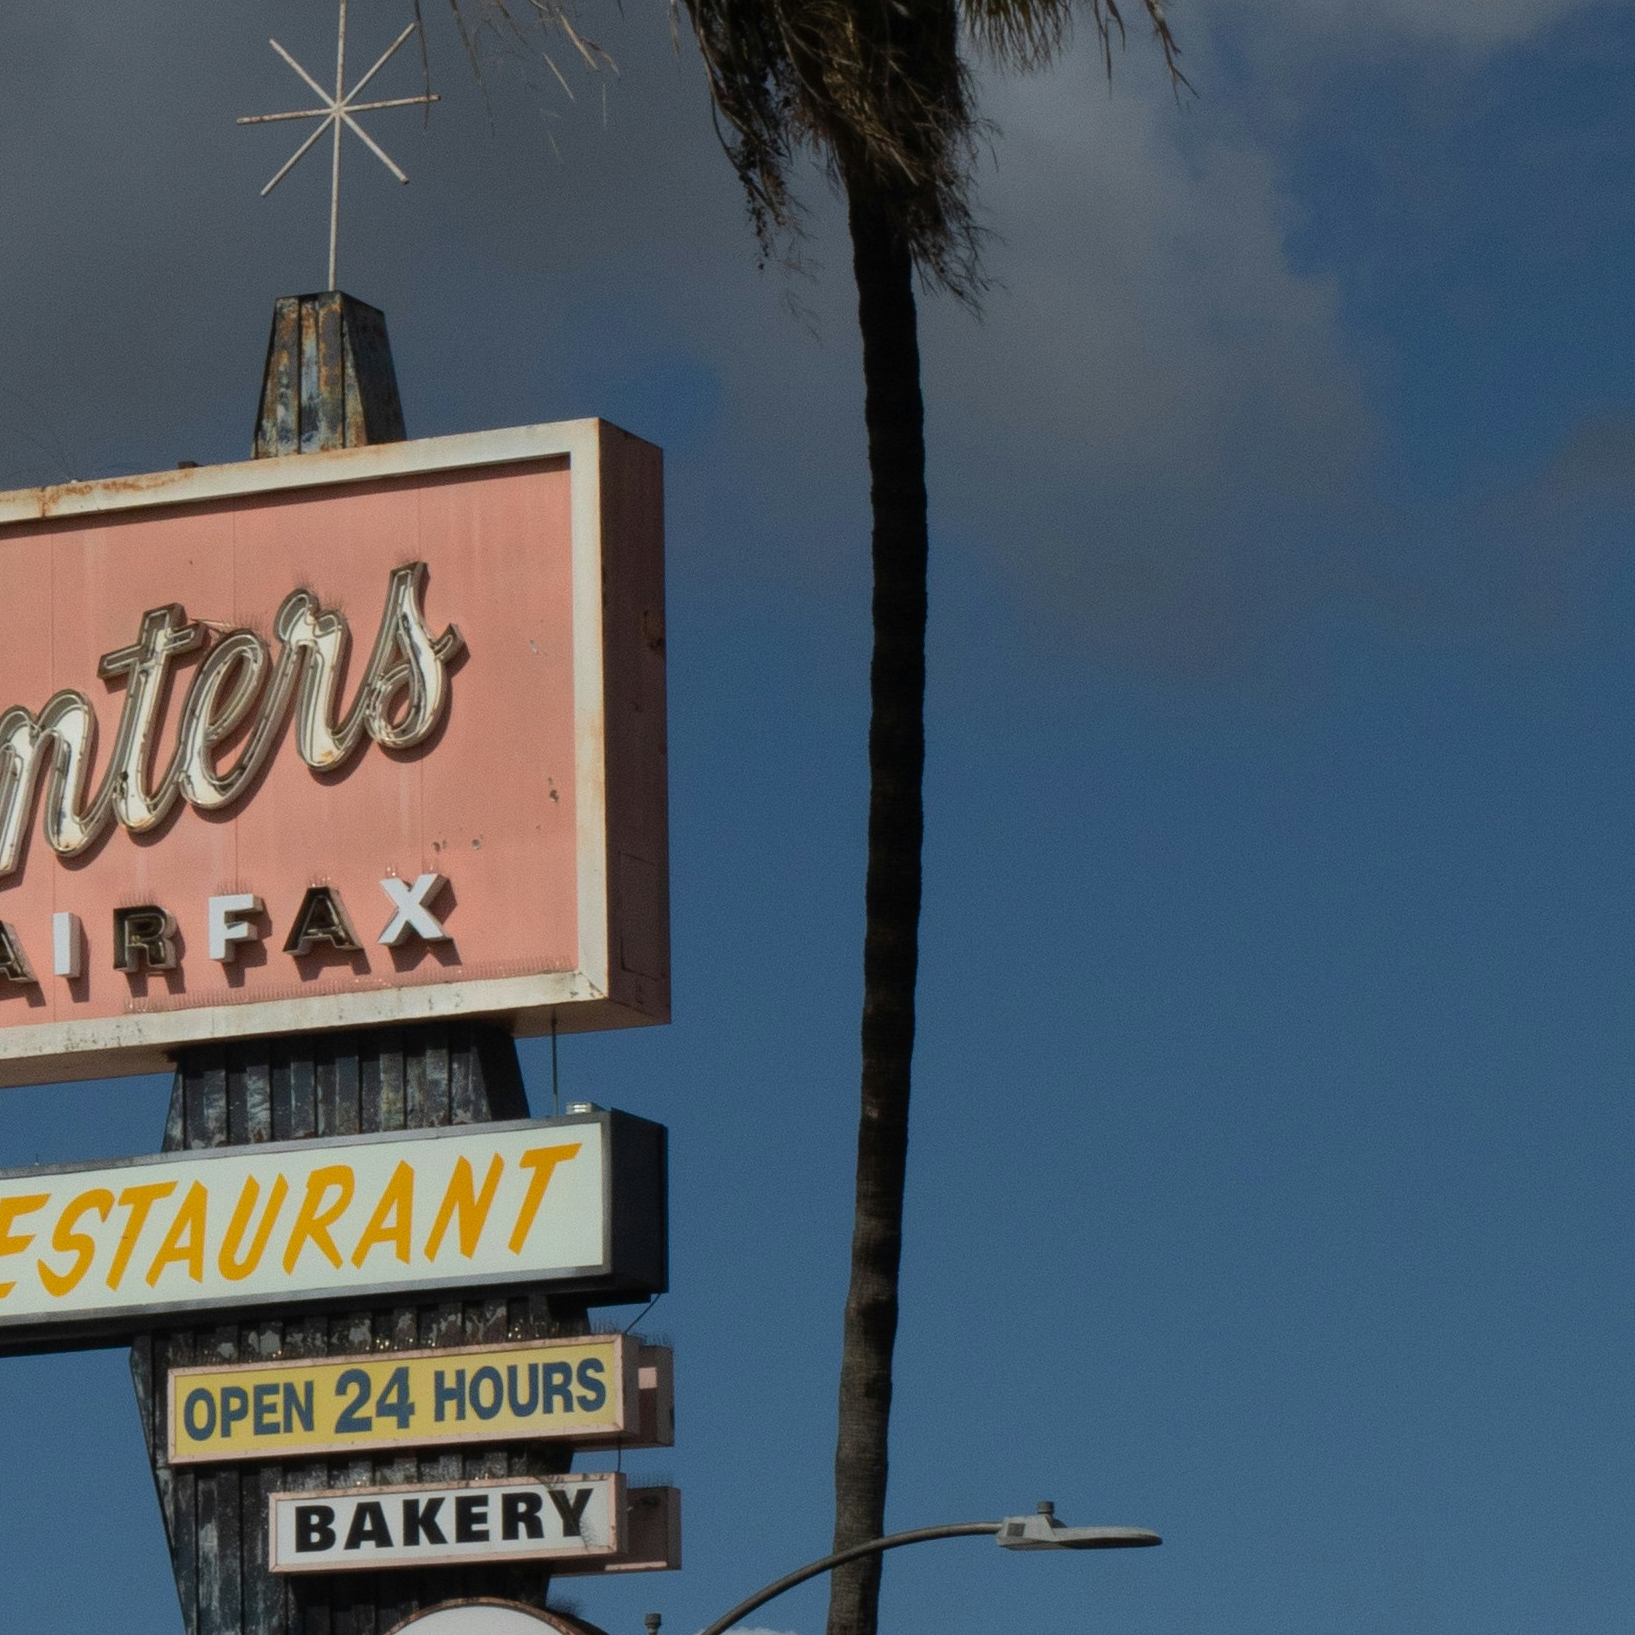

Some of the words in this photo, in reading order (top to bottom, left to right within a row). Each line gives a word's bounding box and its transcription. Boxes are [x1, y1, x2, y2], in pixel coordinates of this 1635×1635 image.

[183, 1378, 315, 1442] OPEN
[334, 1366, 415, 1434] 24
[435, 1357, 607, 1423] HOURS
[294, 1487, 593, 1554] BAKERY
